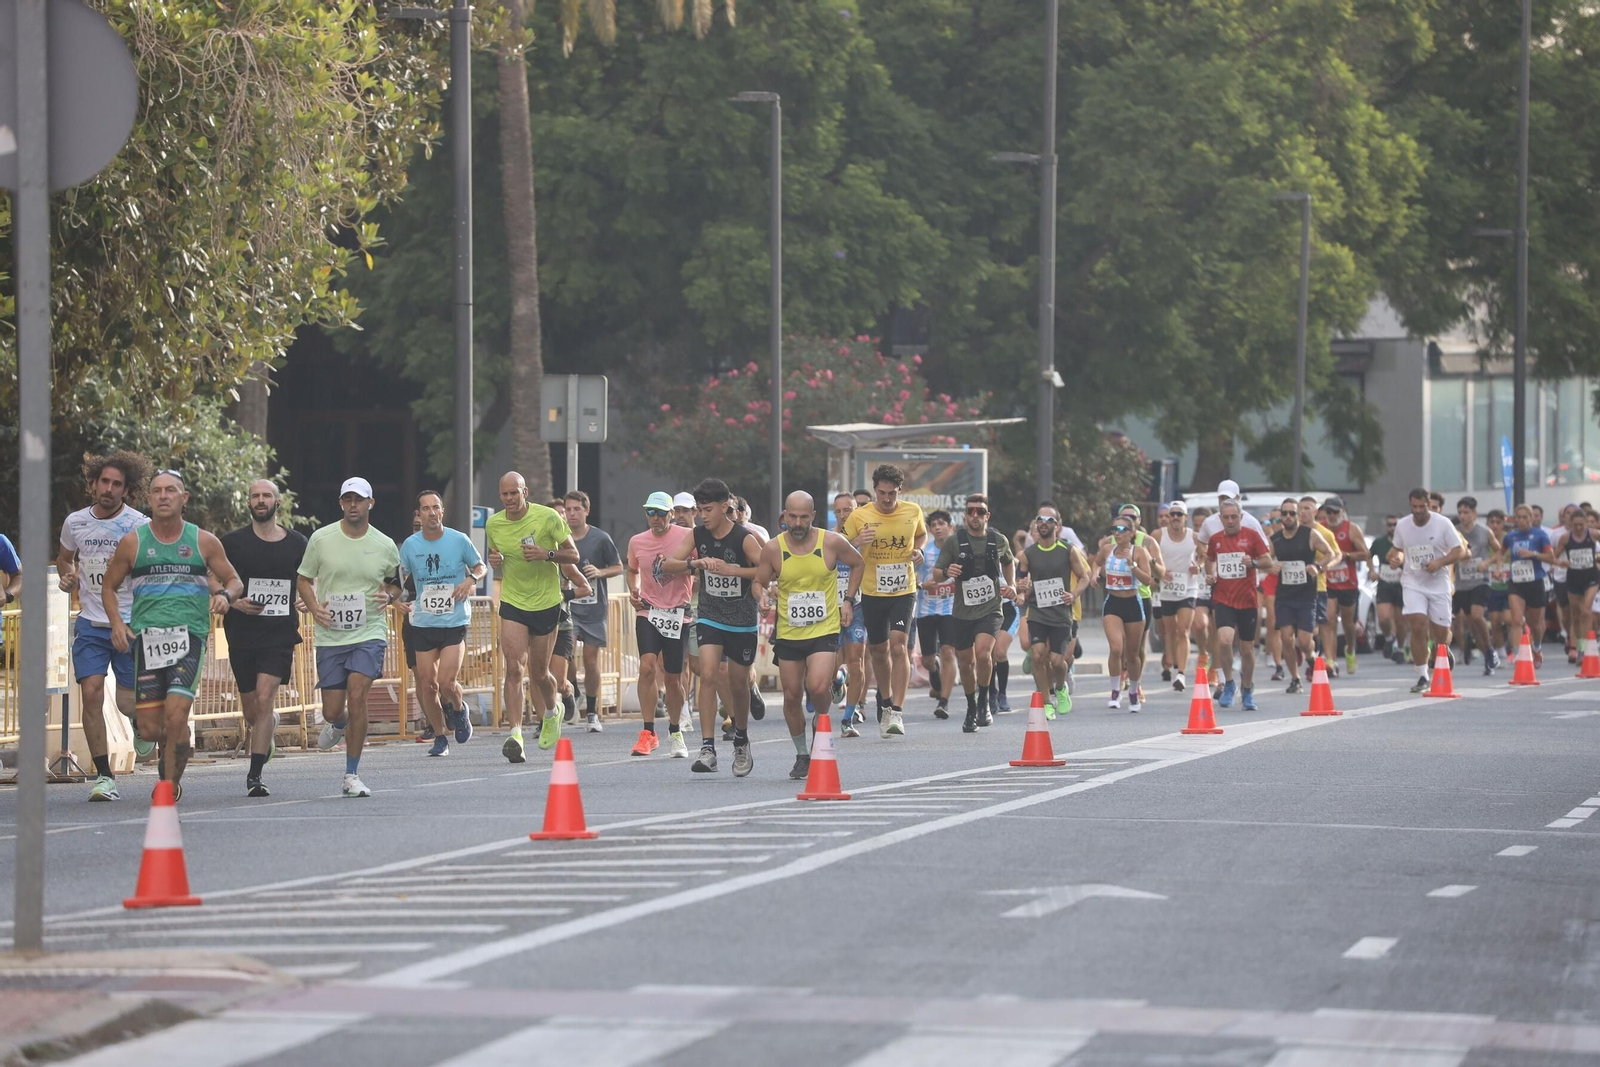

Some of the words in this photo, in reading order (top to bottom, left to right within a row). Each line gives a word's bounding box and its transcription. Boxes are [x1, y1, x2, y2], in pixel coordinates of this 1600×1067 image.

[84, 538, 119, 548] mayora
[150, 565, 191, 573] ATLETISMO
[1221, 563, 1244, 572] 7815
[880, 575, 906, 586] 5547
[1284, 571, 1304, 579] 1795
[708, 576, 738, 588] 8384
[1112, 578, 1124, 586] 24
[1163, 582, 1185, 591] 2020
[967, 585, 992, 598] 6332
[1038, 588, 1064, 600] 11168
[250, 593, 288, 605] 10278
[423, 598, 452, 608] 1524
[329, 609, 362, 622] 2187
[791, 606, 824, 618] 8386
[652, 617, 679, 631] 5336
[147, 640, 187, 657] 11994
